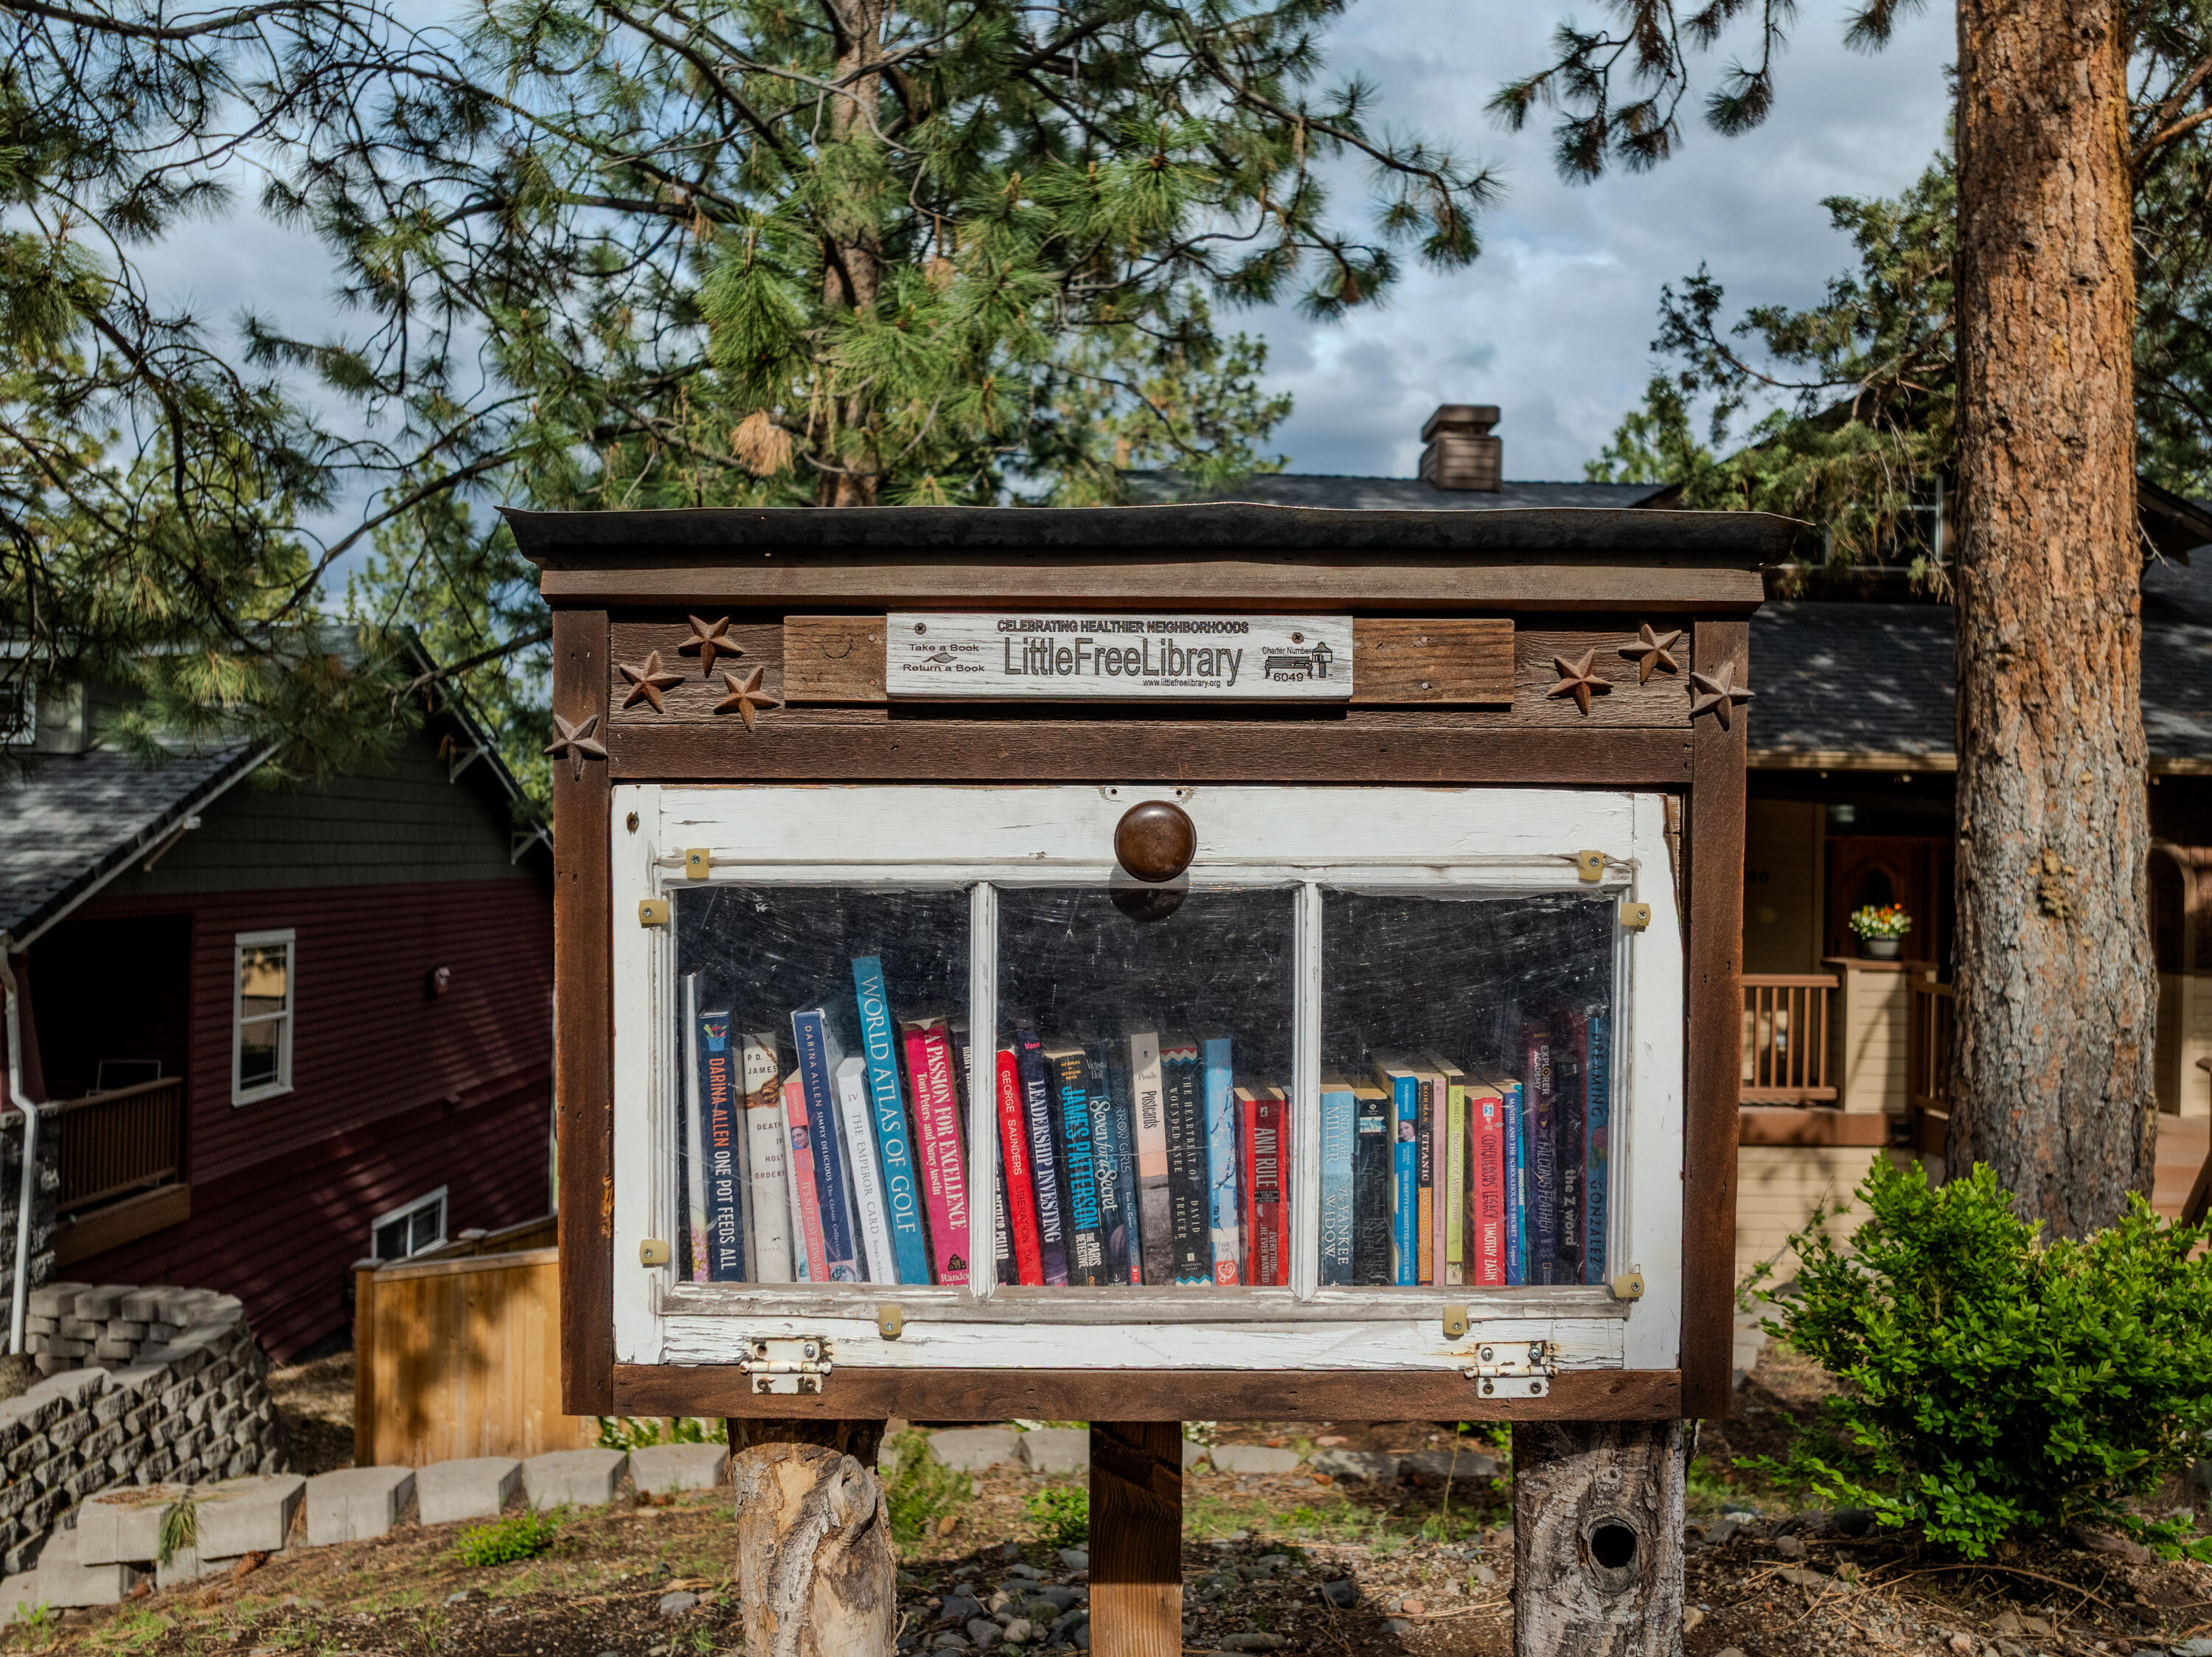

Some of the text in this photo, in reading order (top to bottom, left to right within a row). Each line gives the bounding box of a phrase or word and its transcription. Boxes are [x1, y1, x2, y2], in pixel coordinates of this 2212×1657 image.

[998, 619, 1249, 633] CELEBRATING HEALTHIER NEIGHBORHOODS
[909, 644, 936, 652] Take
[950, 644, 979, 652] Book
[1005, 637, 1243, 687] LittleFreeLibrary
[1262, 647, 1312, 655] Charter Number
[1143, 678, 1221, 688] www.littlefreelibrary.org
[1273, 673, 1304, 681] 6049
[804, 1025, 817, 1069] DARINA
[748, 1066, 776, 1074] JAMES
[810, 1072, 822, 1108] ALLEN
[1183, 1076, 1192, 1095] THE
[1533, 1050, 1542, 1091] ACADEMY
[1540, 1044, 1551, 1095] EXPLORER
[1590, 1032, 1604, 1117] DREAMING
[860, 975, 916, 1234] WORLD ATLAS OF GOLF
[1001, 1070, 1015, 1113] GEORGE
[1062, 1086, 1090, 1139] JAMES
[1113, 1074, 1127, 1139] TOMORROW
[1141, 1091, 1160, 1129] Postcards
[816, 1111, 827, 1138] SIMPLY
[917, 1072, 942, 1195] Tom Peters and Nancy Austin
[925, 1035, 967, 1230] A PASSION FOR EXCELLENCE
[1169, 1087, 1182, 1173] WOUNDED KNEE
[1184, 1102, 1196, 1163] HEARTBEAT
[1254, 1128, 1276, 1154] ANN
[1326, 1105, 1340, 1164] MILLER
[1339, 1105, 1351, 1162] LINDA LAEL
[709, 1058, 737, 1270] DARINA ALLEN ONE POT FEEDS ALL
[821, 1141, 832, 1181] DELICIOUS
[1007, 1119, 1023, 1175] SAUNDERS
[1027, 1080, 1061, 1243] LEADERSHIP INVESTING
[1089, 1100, 1119, 1214] Seven for a Secret
[1119, 1142, 1131, 1173] GIRLS
[1422, 1132, 1430, 1181] TITANIC
[1537, 1140, 1552, 1189] FALCON'S
[755, 1170, 785, 1179] ORDERS
[801, 1181, 810, 1197] IT'S
[852, 1112, 880, 1258] THE EMPEROR CARD Bevan
[1067, 1141, 1099, 1230] PATTERSON
[1255, 1158, 1278, 1189] RULE
[1374, 1168, 1385, 1215] Alexander
[1452, 1166, 1461, 1176] of
[804, 1198, 814, 1215] NOT
[828, 1199, 837, 1221] Classic
[1015, 1185, 1030, 1243] LIBERATION
[1175, 1197, 1186, 1240] TREUER
[1190, 1200, 1200, 1234] DAVID
[1452, 1178, 1460, 1222] Winn-Dixie
[1481, 1134, 1499, 1281] CONQUERORS' LEGACY TIMOTHY ZAHN
[1537, 1189, 1553, 1233] FEATHER
[1563, 1169, 1576, 1246] the Z word
[806, 1217, 817, 1236] EASY
[832, 1224, 841, 1257] Collection
[1086, 1232, 1095, 1243] THE
[1324, 1193, 1336, 1259] WIDOW
[1338, 1186, 1349, 1265] The YANKEE
[1589, 1179, 1603, 1264] GONZALEZ
[809, 1237, 820, 1262] BEING
[1023, 1249, 1033, 1268] DAY
[1075, 1234, 1089, 1268] DETECTIVE
[1088, 1242, 1102, 1267] PARIS
[1261, 1237, 1269, 1254] EVER
[1269, 1232, 1278, 1273] EVERYTHING
[1374, 1217, 1386, 1277] PANTHER
[1509, 1246, 1517, 1266] Leppard
[1261, 1254, 1270, 1282] WANTED
[1364, 1259, 1374, 1277] SKY
